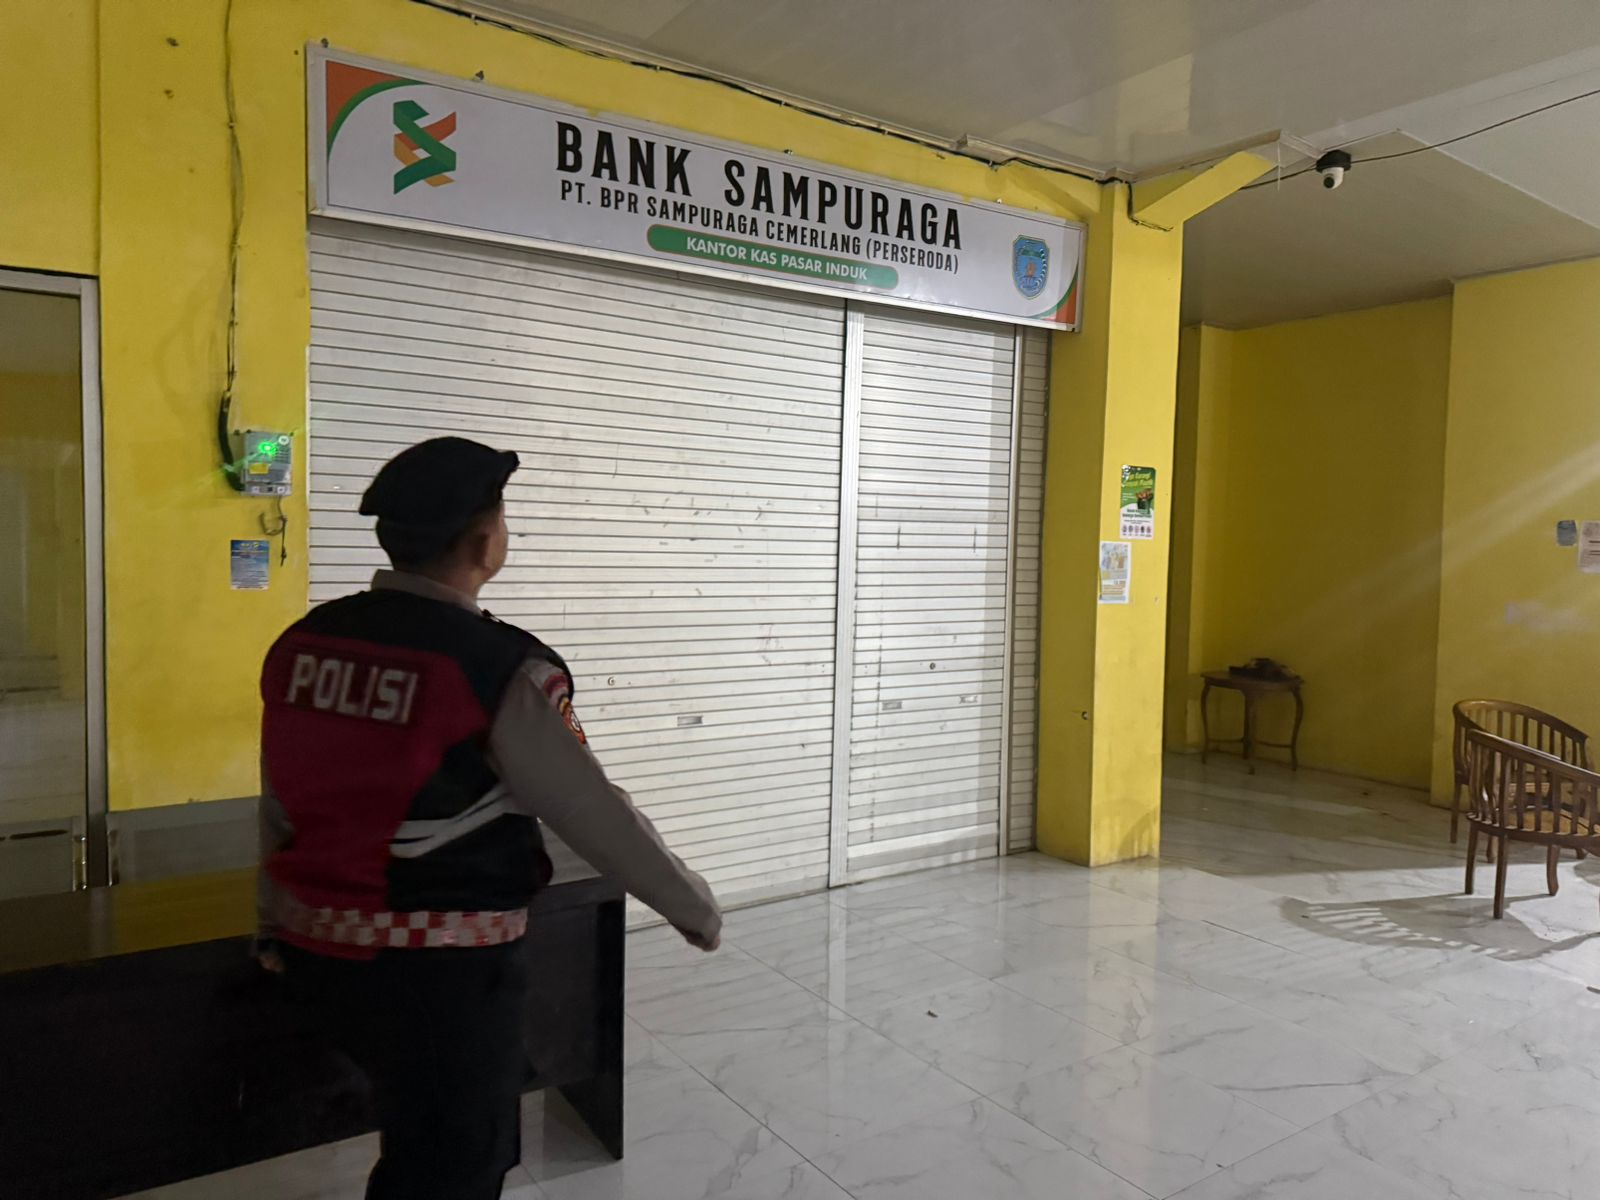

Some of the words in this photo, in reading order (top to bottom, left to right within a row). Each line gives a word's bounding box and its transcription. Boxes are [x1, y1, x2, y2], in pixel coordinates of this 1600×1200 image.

[556, 121, 692, 197] BANK
[724, 159, 962, 250] SAMPURAGA
[561, 179, 591, 205] PT.
[600, 187, 639, 214] BPR
[647, 196, 759, 237] SAMPURAGA
[766, 220, 861, 255] CEMERLANG
[866, 238, 959, 274] (PERSERODA)
[687, 237, 746, 260] KANTOR
[751, 247, 777, 264] KAS
[781, 252, 822, 272] PASAR
[826, 263, 867, 280] INDUK
[286, 654, 418, 724] POLISI
